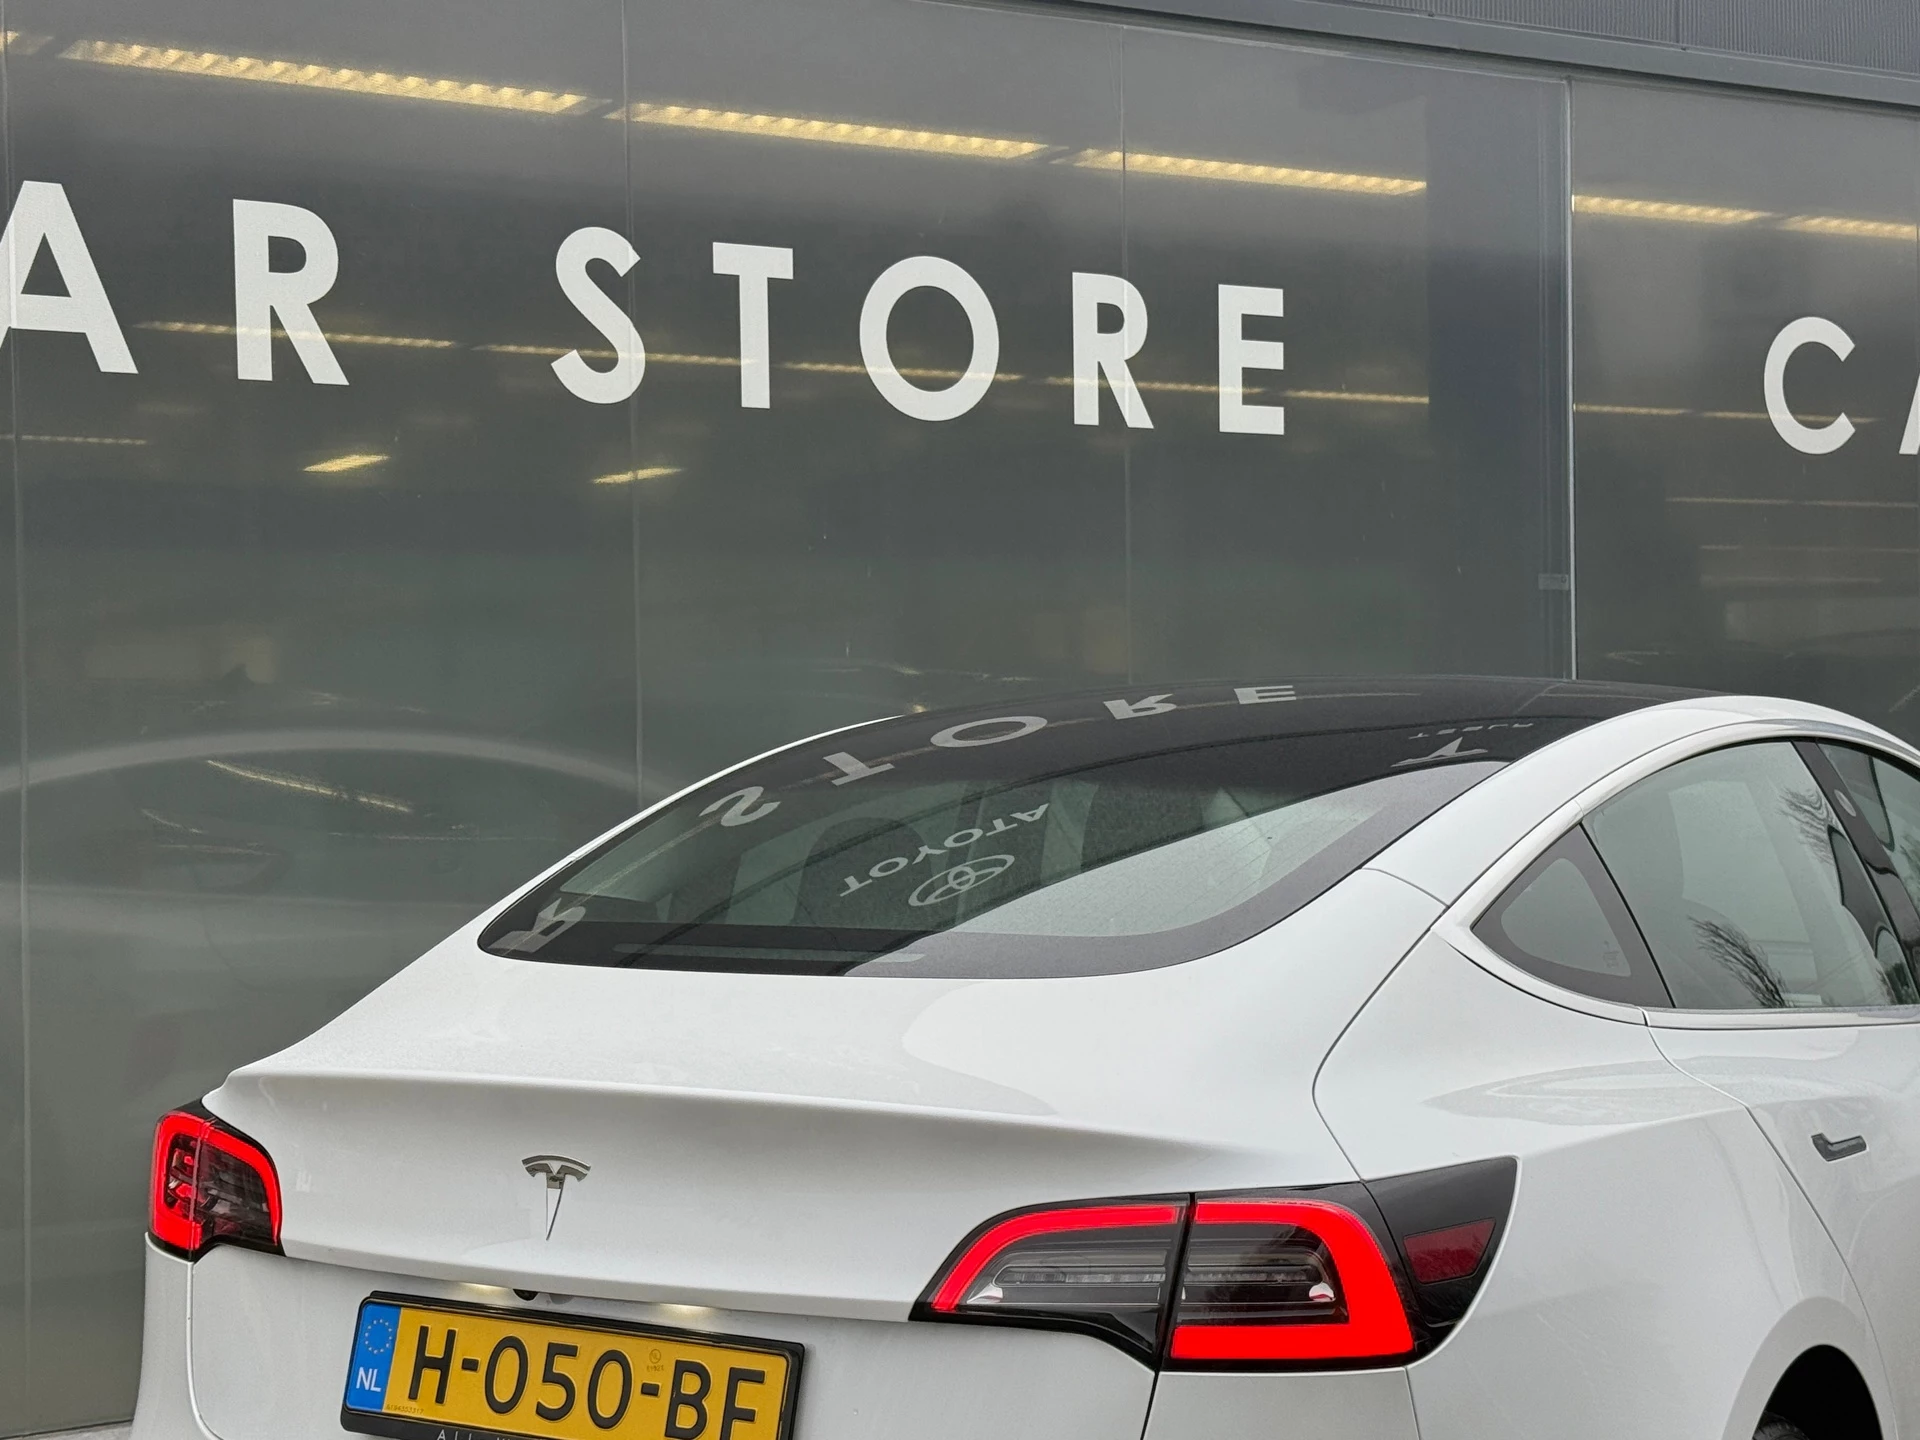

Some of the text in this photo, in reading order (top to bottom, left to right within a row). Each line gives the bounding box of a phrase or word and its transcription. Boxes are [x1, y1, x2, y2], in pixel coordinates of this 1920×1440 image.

[551, 226, 1286, 434] STORE
[1764, 316, 1920, 455] C
[356, 1367, 382, 1392] NL
[408, 1326, 765, 1440] H-050-BF
